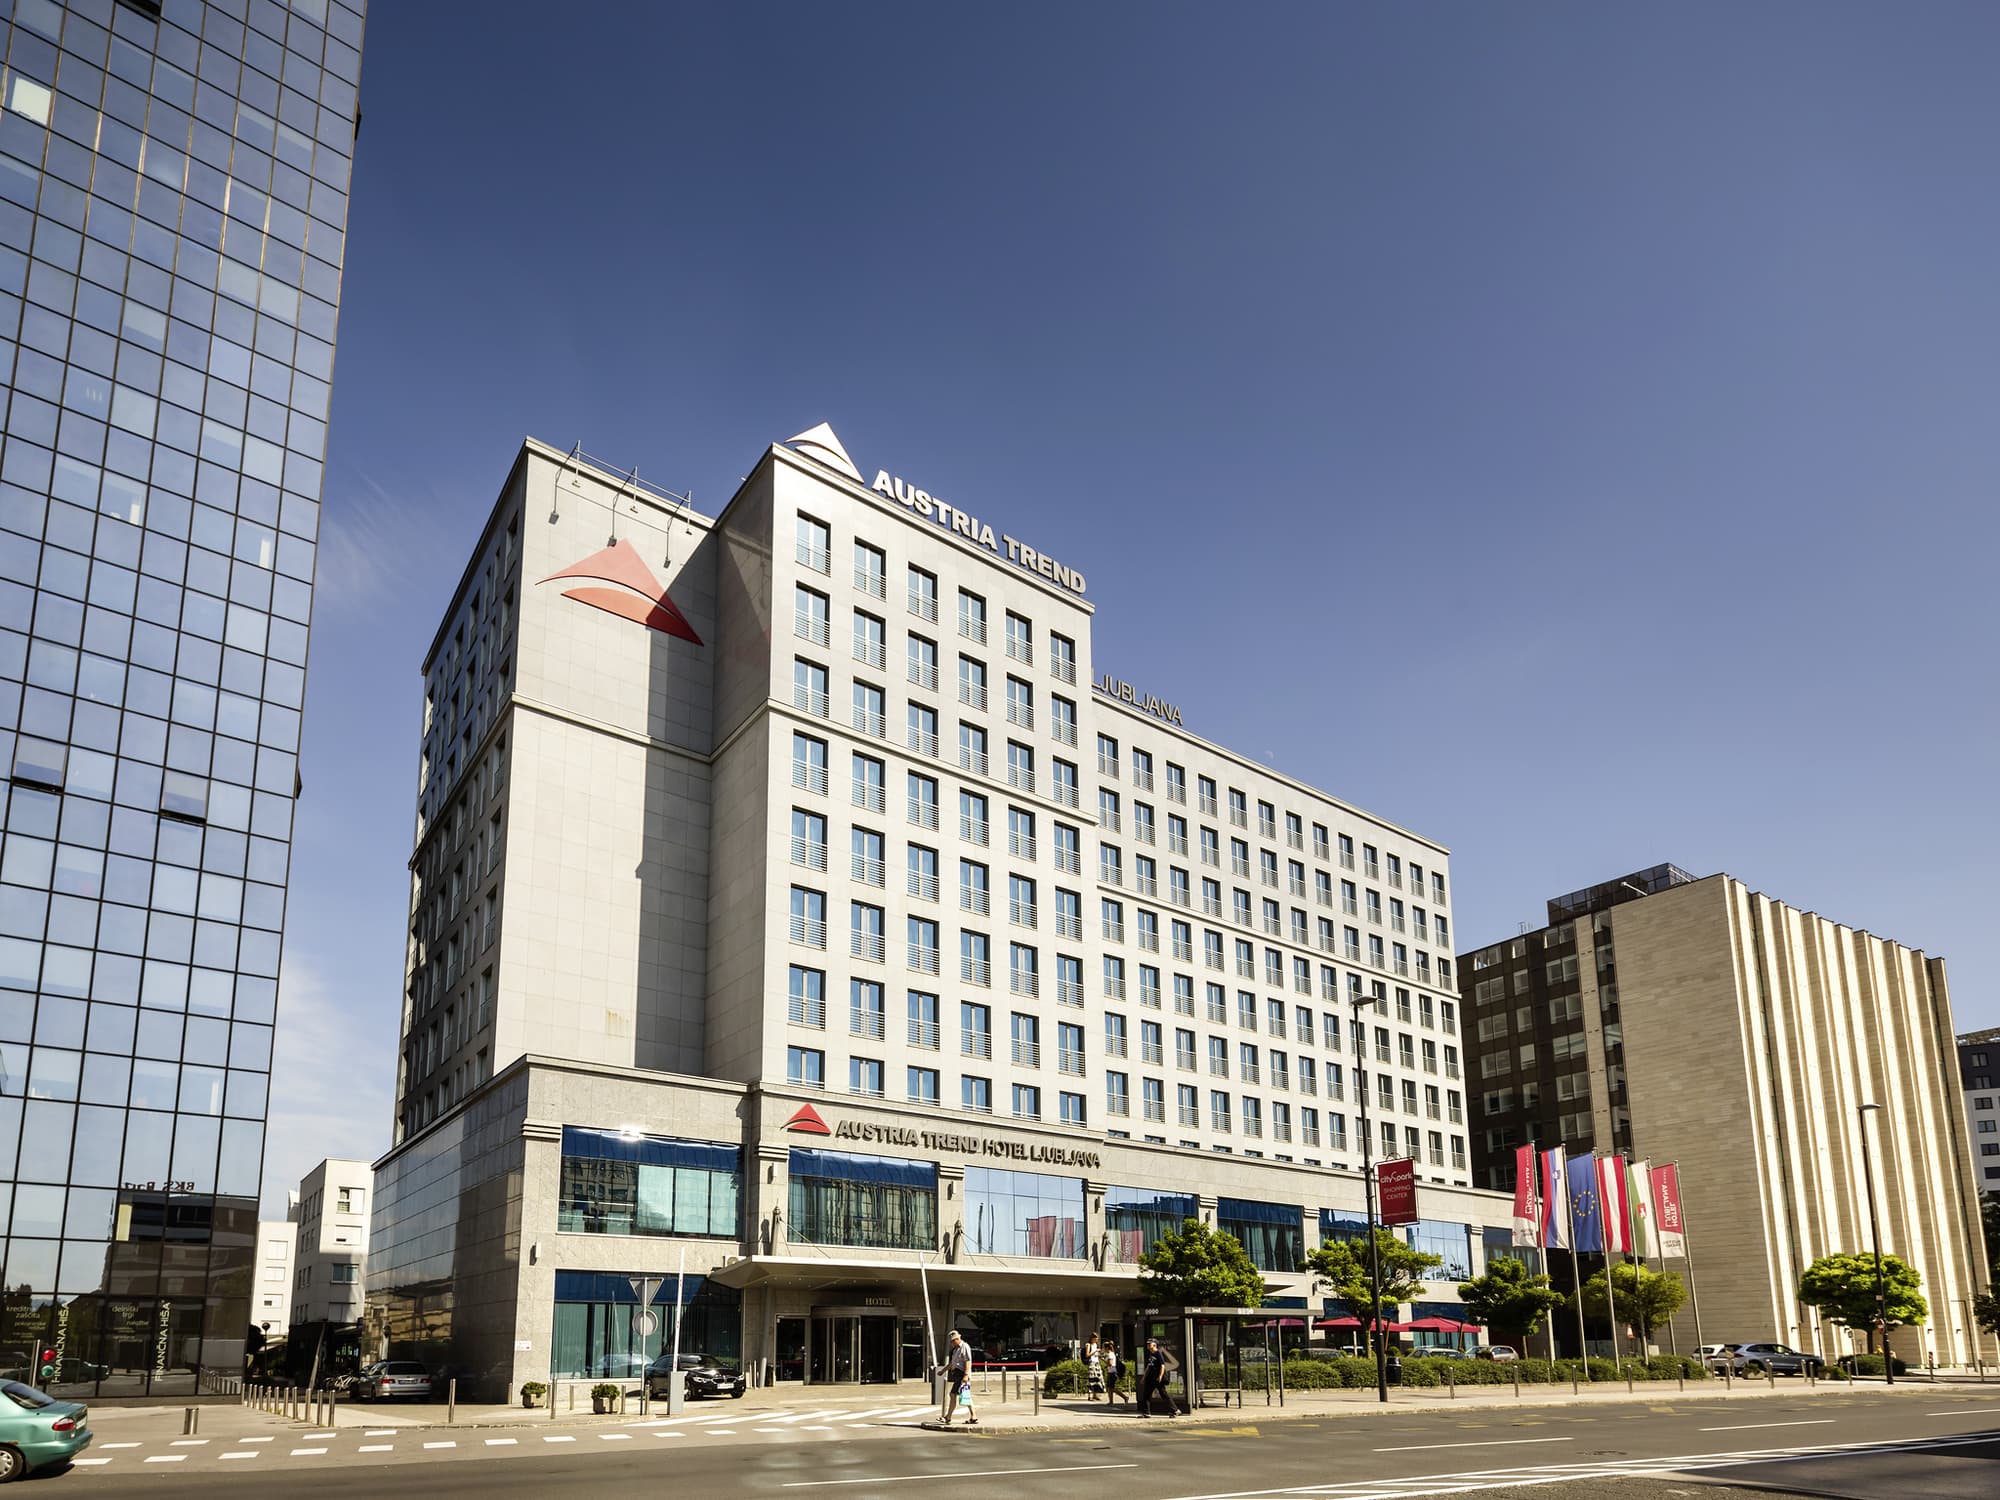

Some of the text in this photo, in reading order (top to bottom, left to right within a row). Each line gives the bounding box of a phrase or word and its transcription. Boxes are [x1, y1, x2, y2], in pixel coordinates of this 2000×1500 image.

[871, 469, 1087, 594] AUSTRIA TREND
[1091, 667, 1183, 726] LJUBLJANA
[835, 1119, 1100, 1169] AUSTRIA TREND HOTEL LJUBLJANA
[1386, 1192, 1407, 1200] CENTER
[57, 1302, 70, 1327] HIŠA
[865, 1297, 893, 1306] HOTEL
[153, 1328, 169, 1381] FINANČNA
